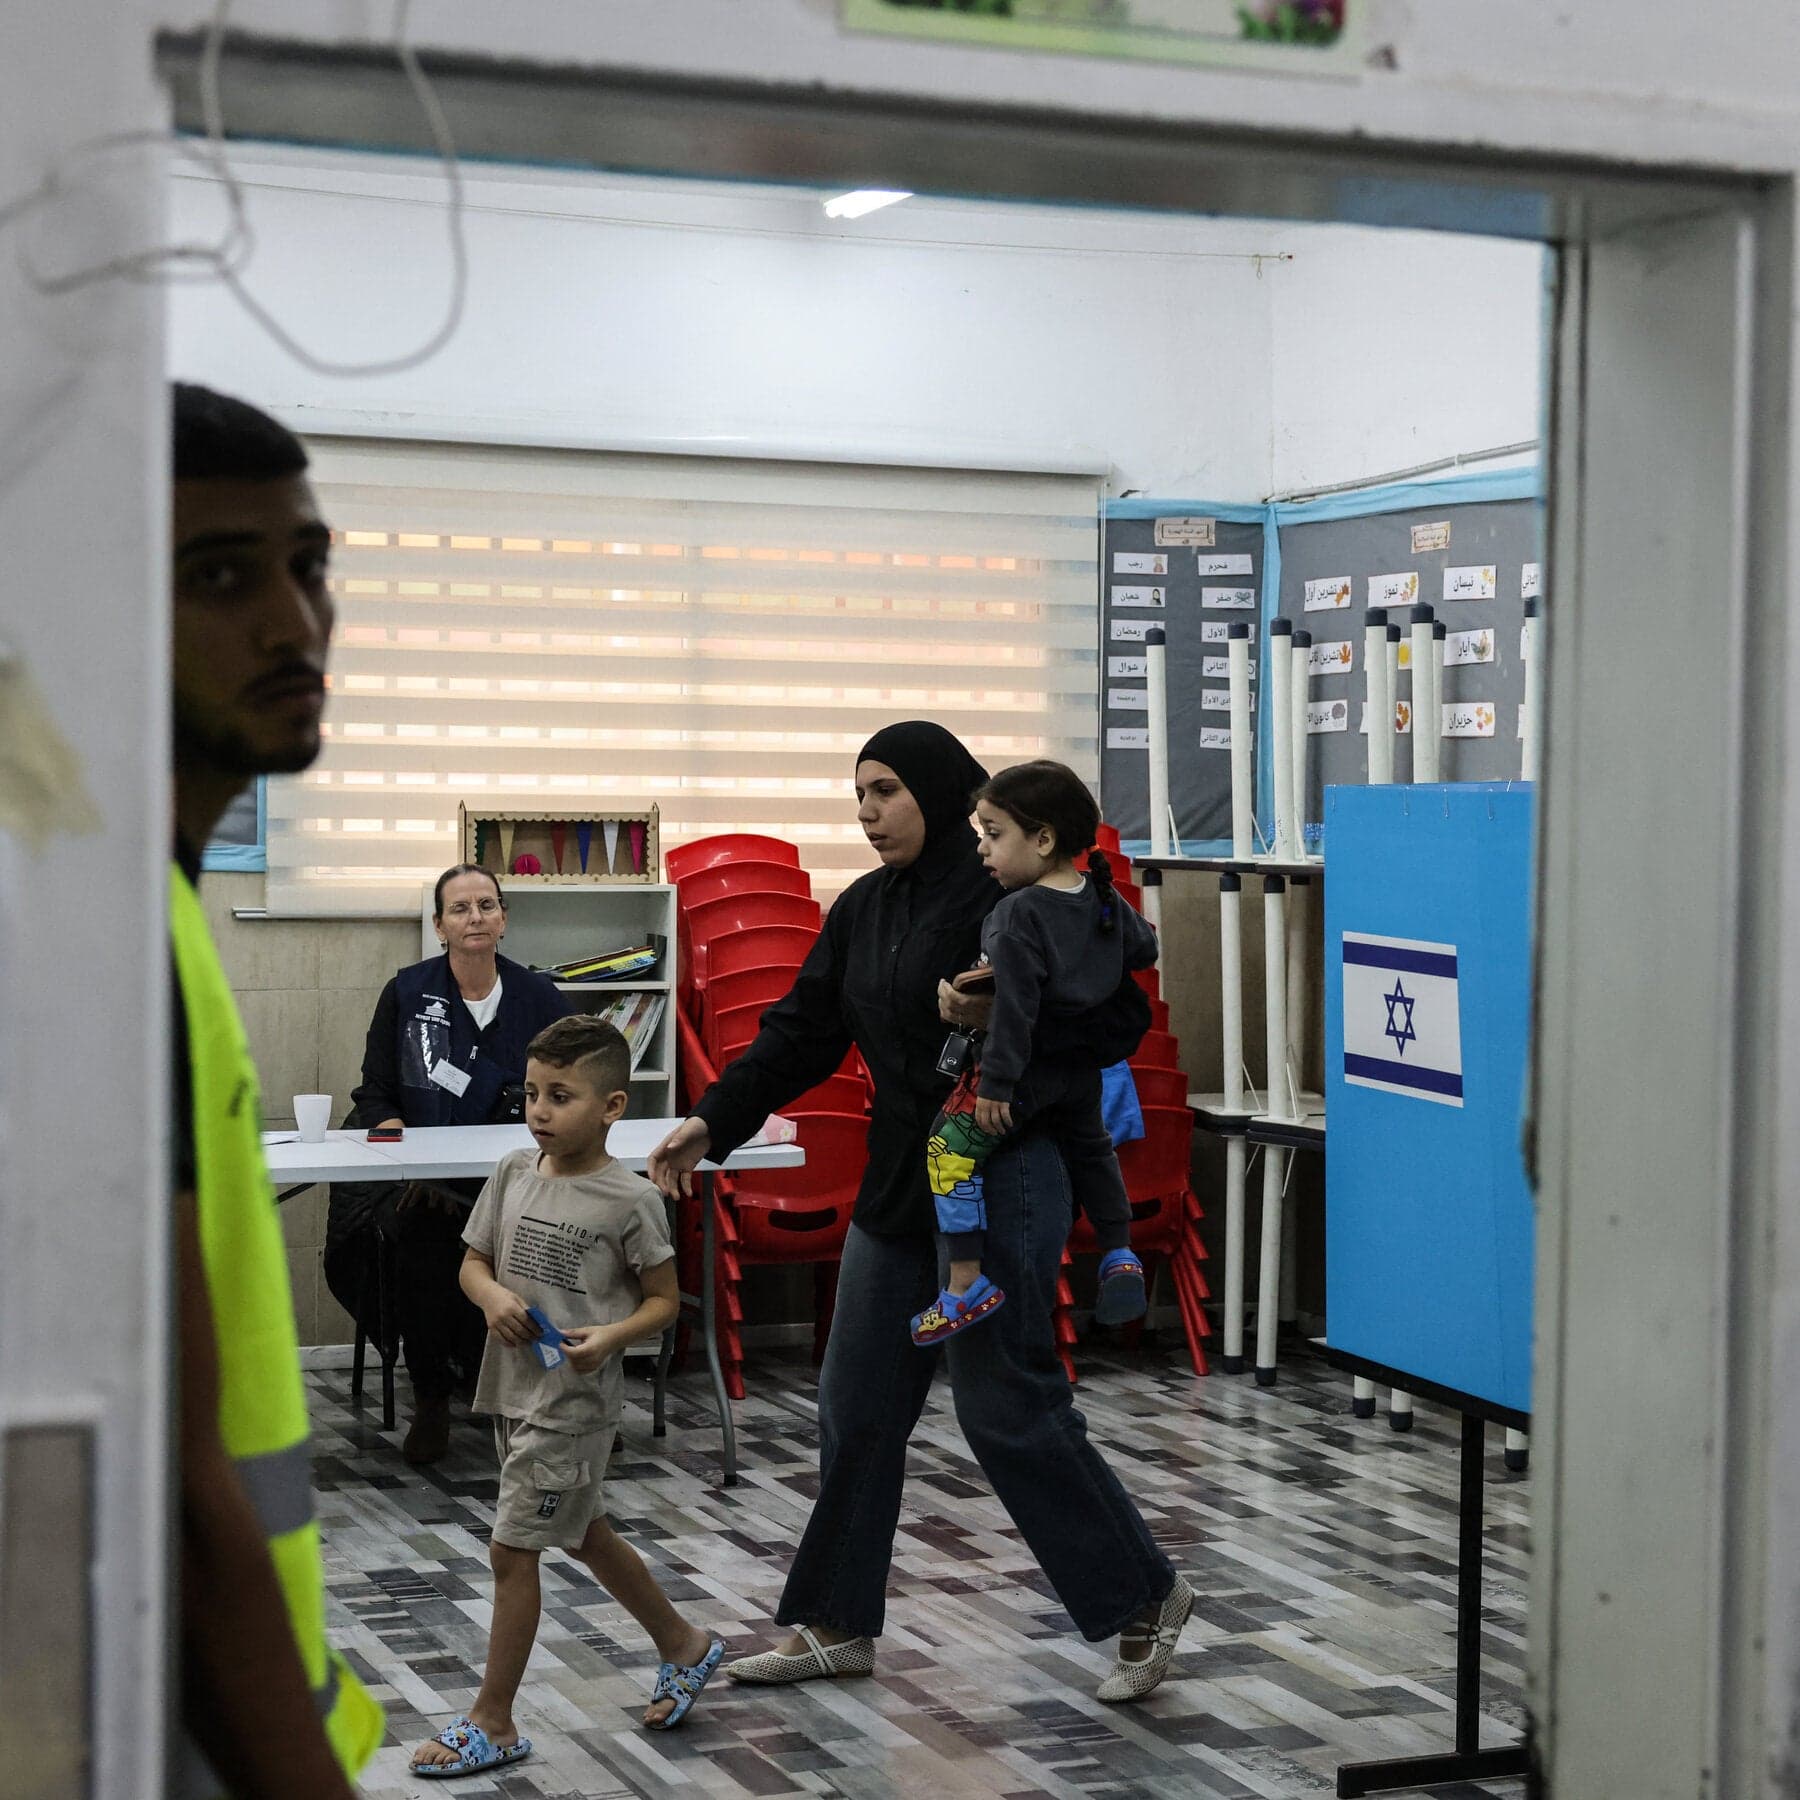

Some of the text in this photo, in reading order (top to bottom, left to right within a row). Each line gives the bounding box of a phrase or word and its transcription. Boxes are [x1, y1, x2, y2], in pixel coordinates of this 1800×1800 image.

[1128, 560, 1143, 569] رجب
[1453, 575, 1474, 592] نيسان
[1120, 592, 1140, 602] شعبان
[1215, 592, 1231, 603] صفر
[1317, 583, 1337, 600] تشرين
[1383, 583, 1398, 600] تموز
[1116, 626, 1141, 638] رمضان
[1118, 661, 1139, 673] شوال
[1314, 711, 1330, 726] كانون
[1448, 712, 1473, 731] حزيران
